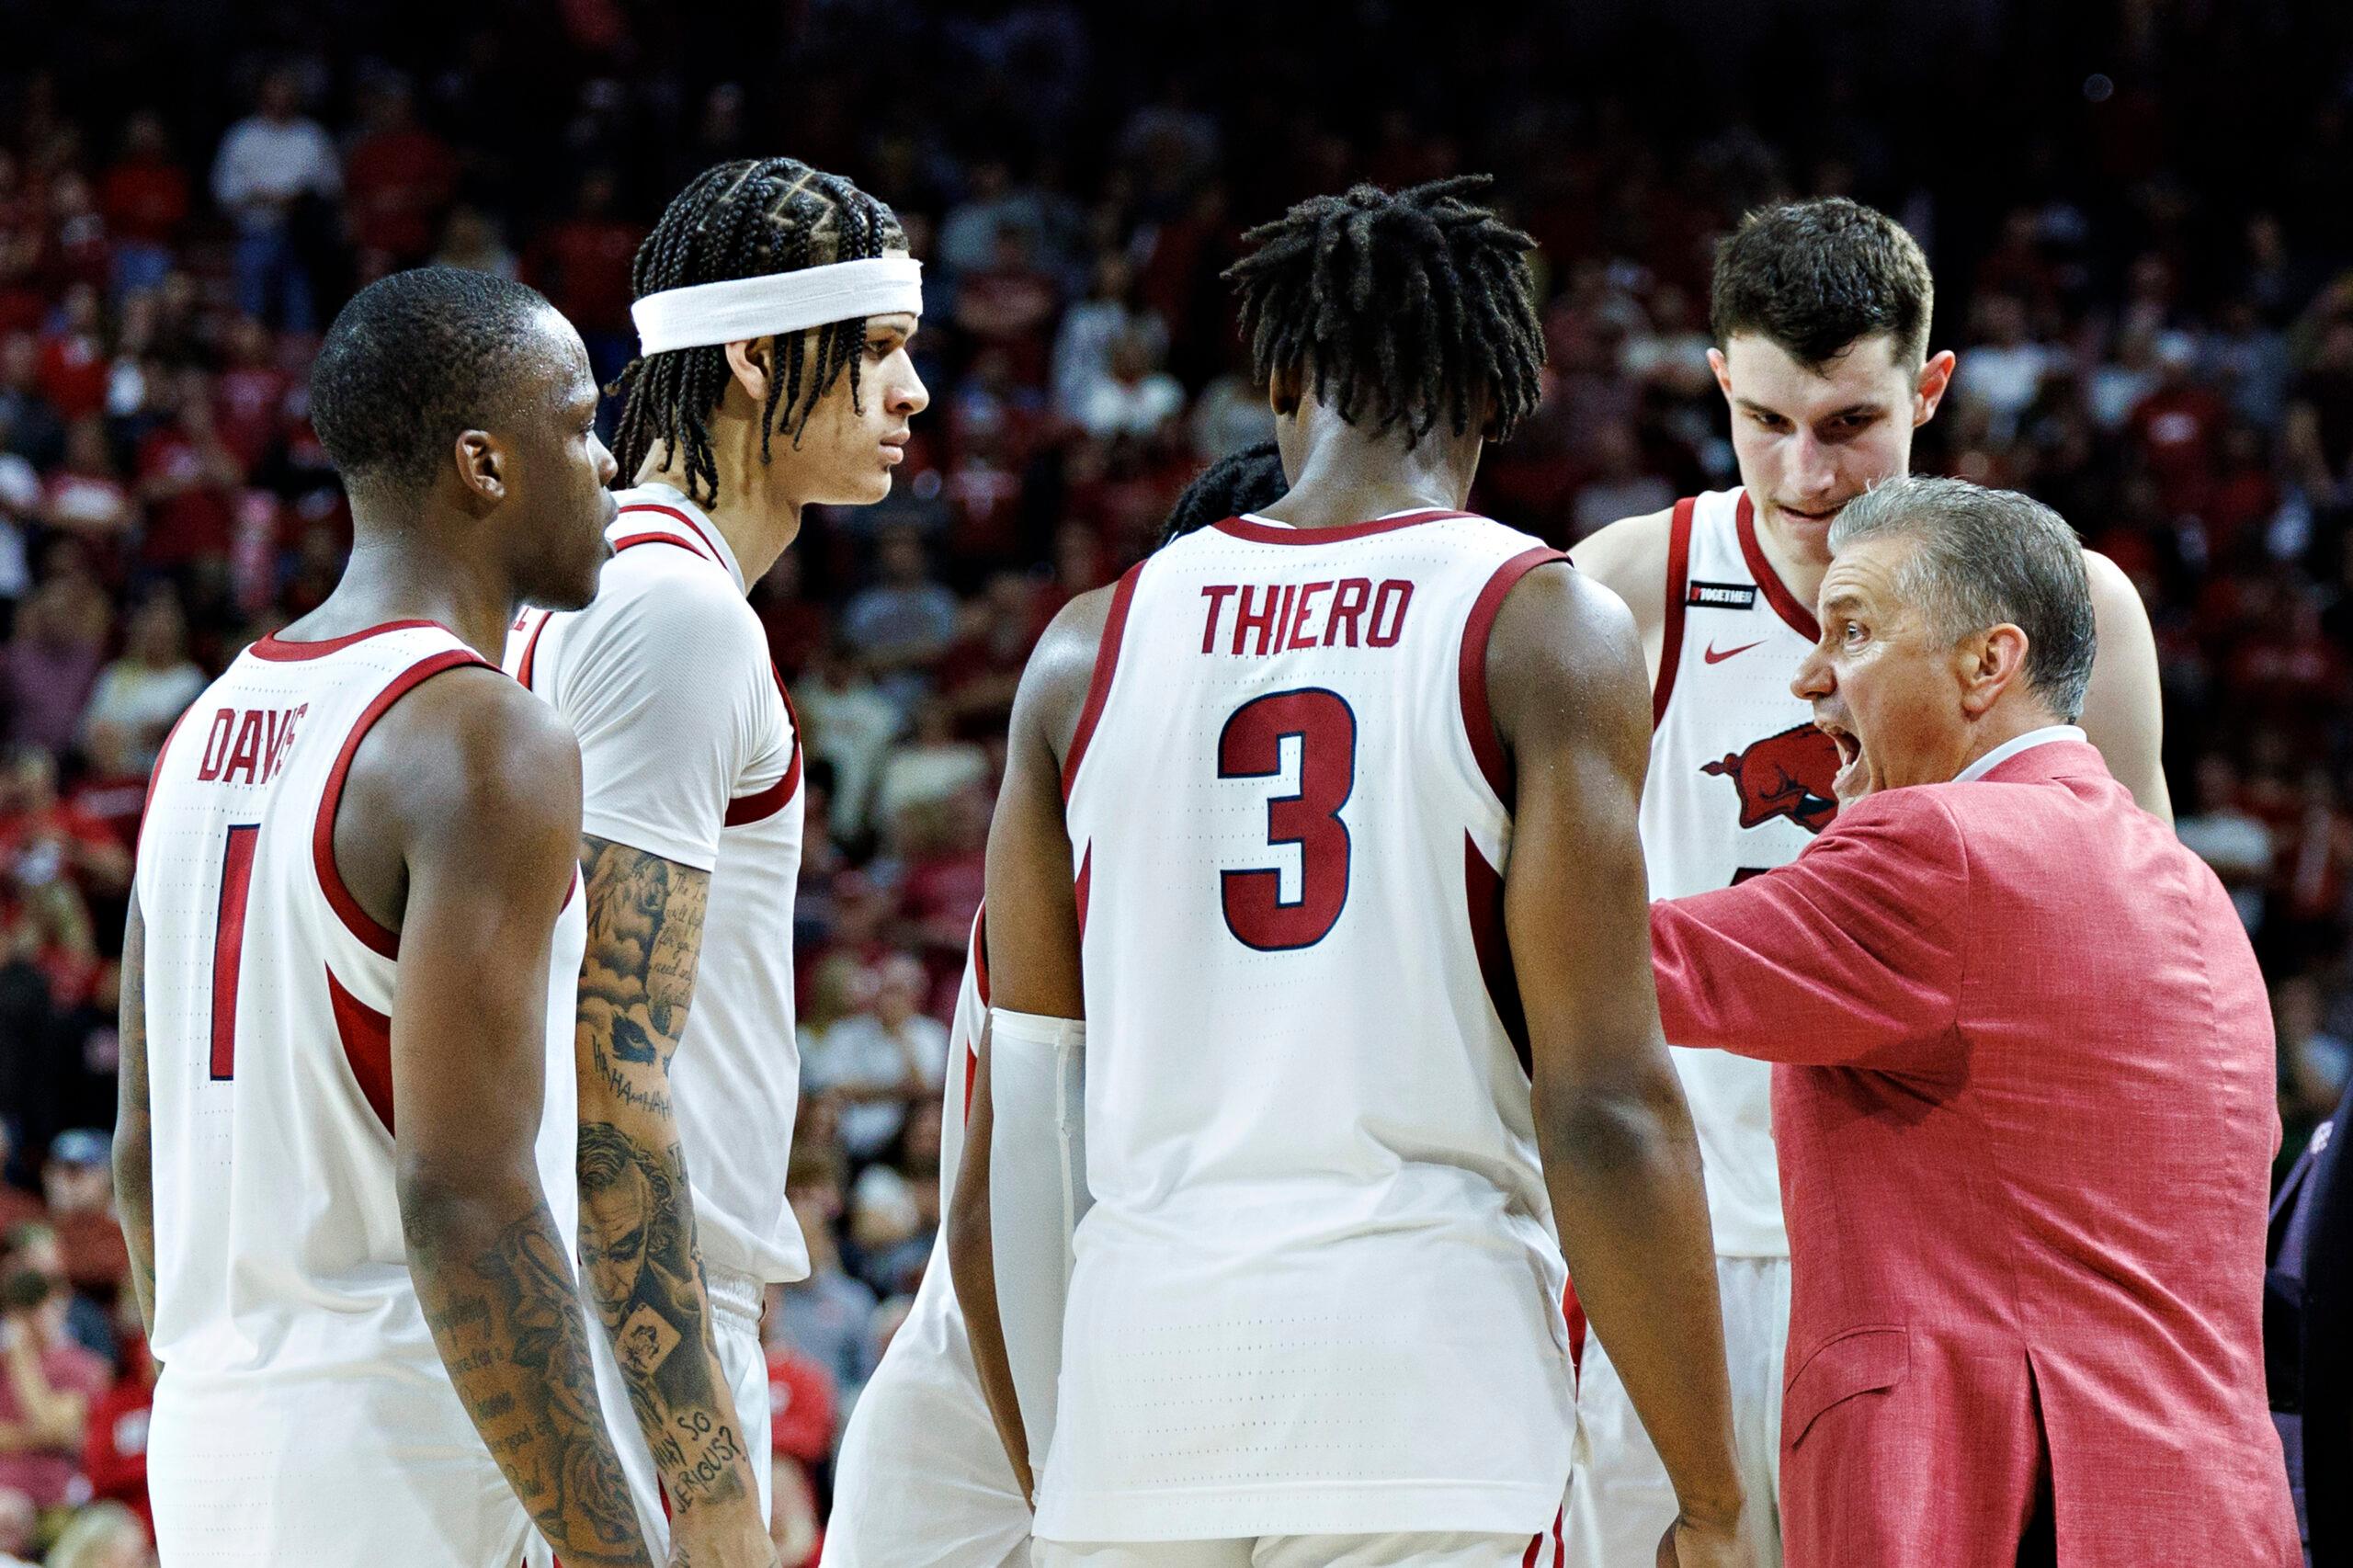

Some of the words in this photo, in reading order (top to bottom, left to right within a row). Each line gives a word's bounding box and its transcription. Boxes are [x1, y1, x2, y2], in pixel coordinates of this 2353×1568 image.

[1200, 577, 1415, 656] THIERO
[1217, 687, 1358, 952] 3
[210, 824, 261, 1081] 1
[677, 1412, 711, 1442] SO
